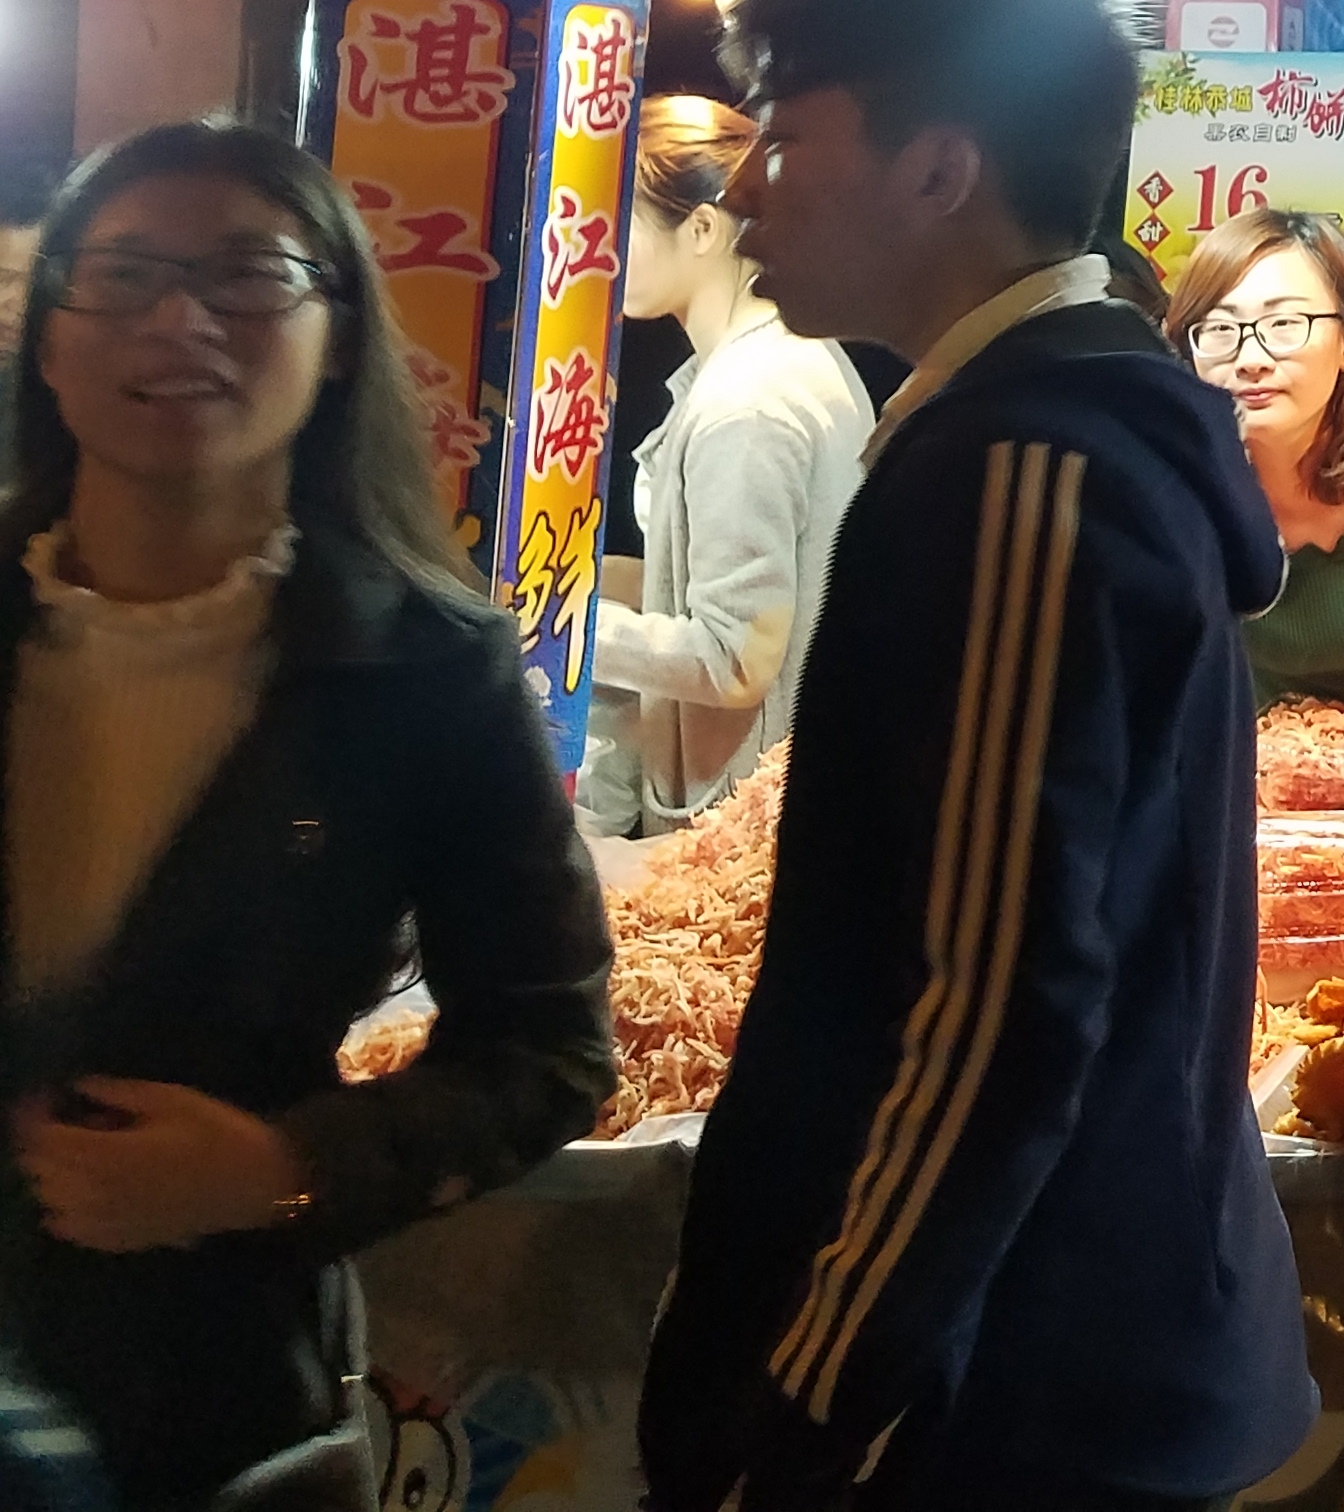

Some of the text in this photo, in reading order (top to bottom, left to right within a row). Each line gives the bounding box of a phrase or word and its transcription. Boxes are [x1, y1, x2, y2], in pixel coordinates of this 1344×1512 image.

[1152, 84, 1254, 118] 桂林恭城
[1186, 164, 1270, 232] 16
